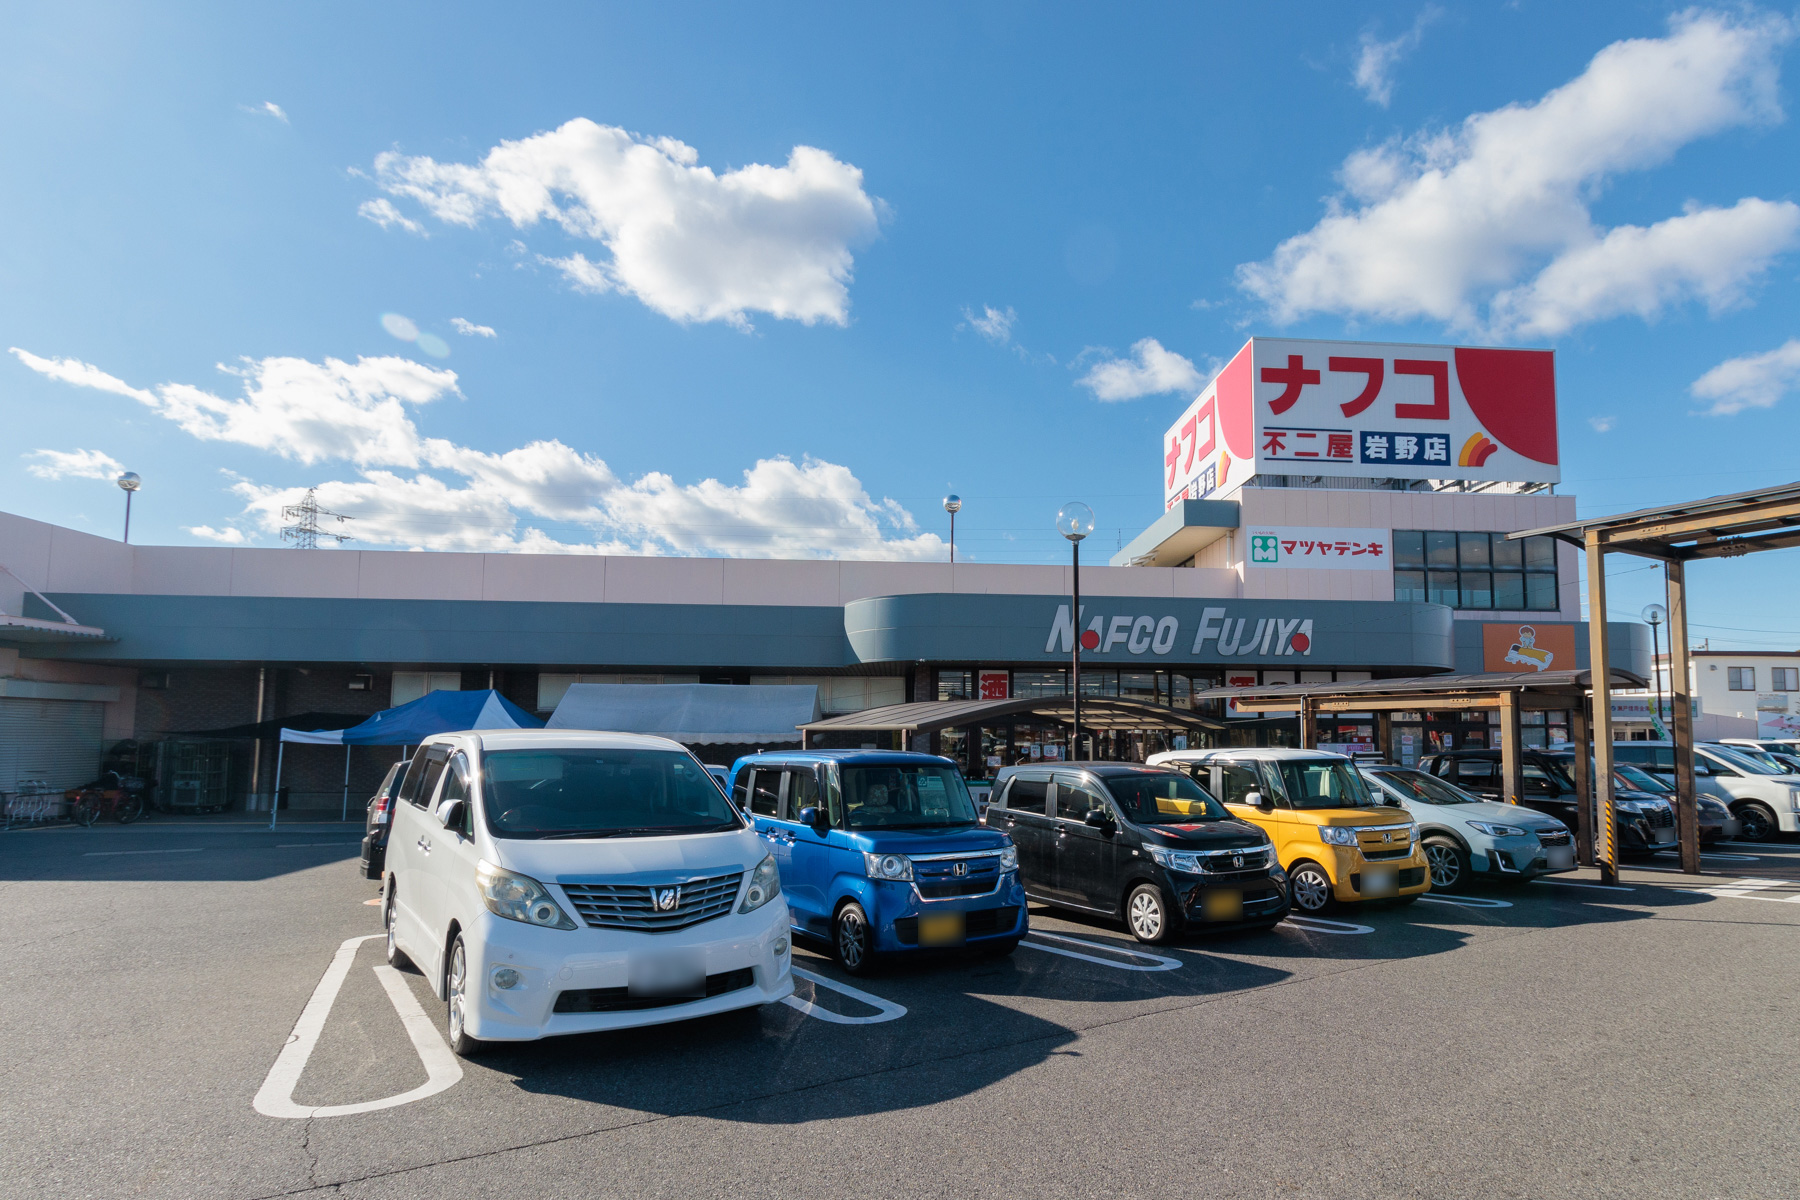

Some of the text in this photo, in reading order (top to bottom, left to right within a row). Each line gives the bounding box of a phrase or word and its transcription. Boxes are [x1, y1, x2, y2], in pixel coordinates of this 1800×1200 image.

[1261, 354, 1450, 420] ナフコ
[1166, 395, 1216, 490] ナフコ
[1262, 431, 1447, 461] 不二屋 岩野店
[1281, 540, 1383, 556] マツヤデンキ
[1045, 604, 1314, 656] NAFCO FUJIYA
